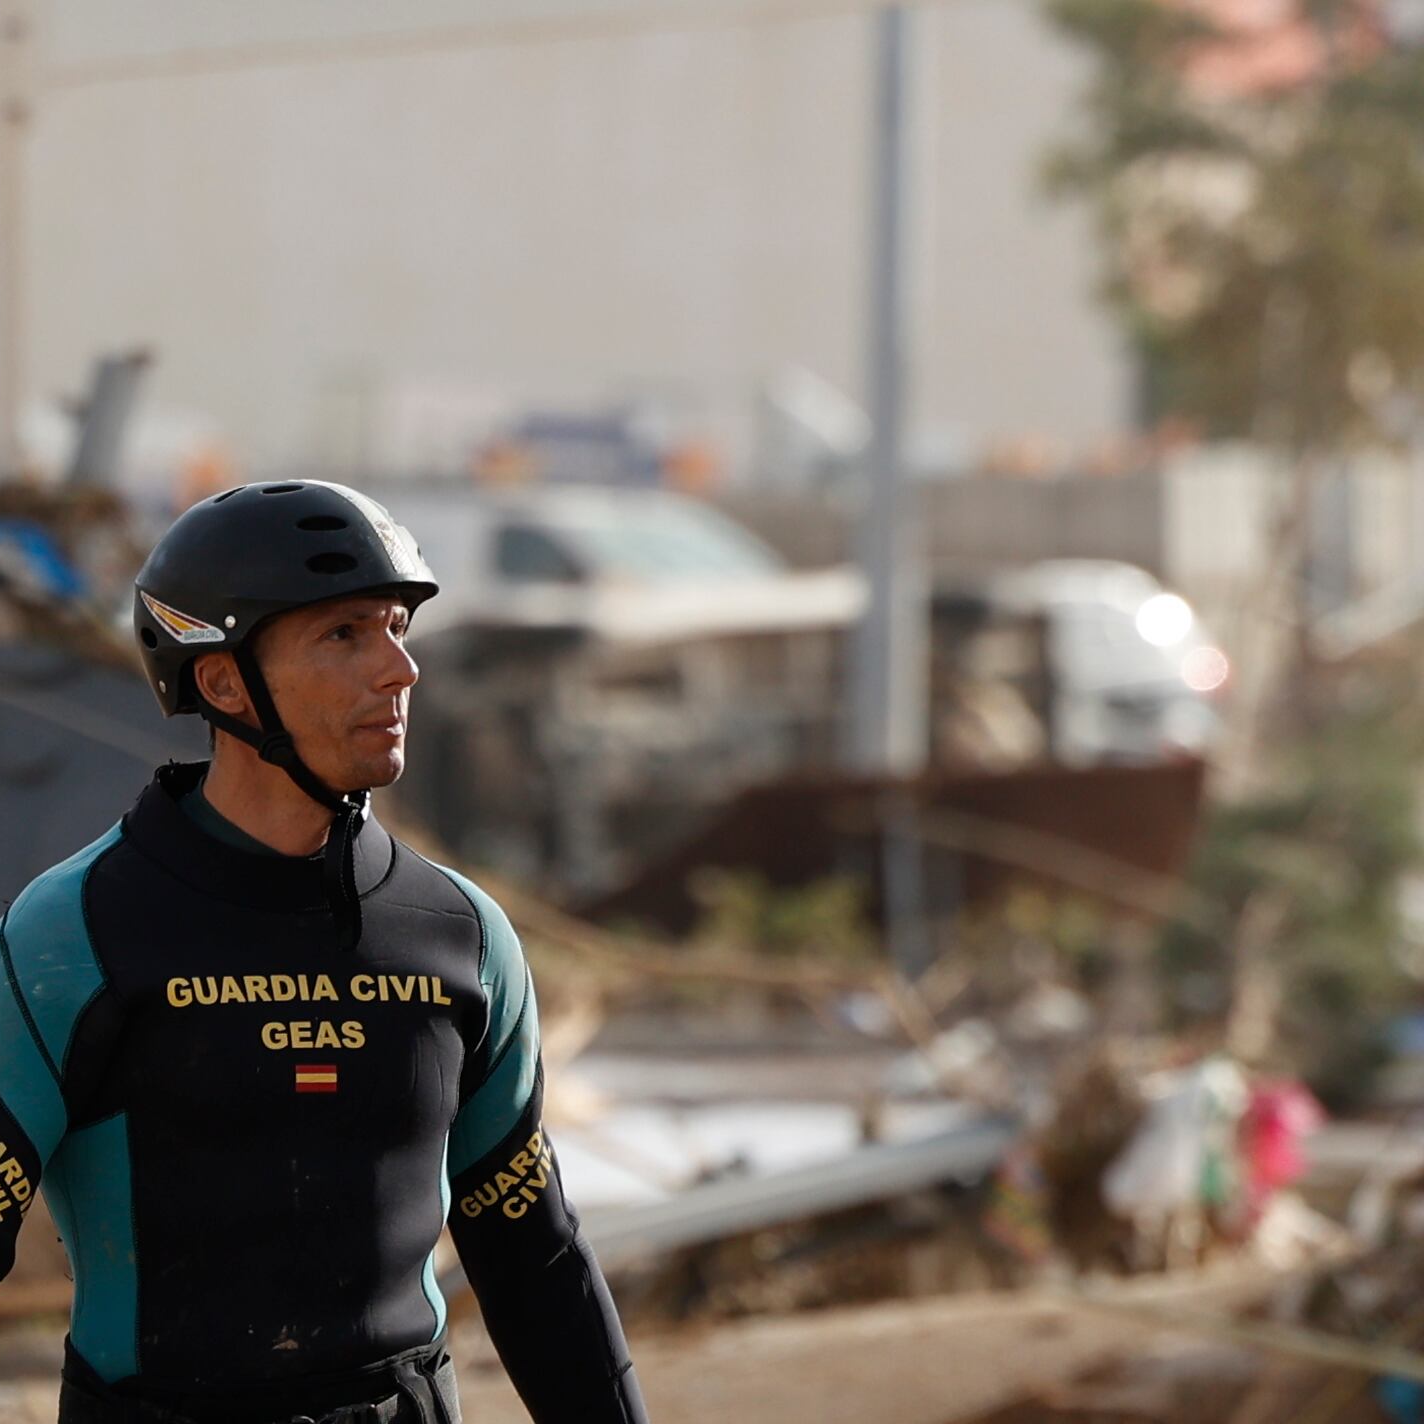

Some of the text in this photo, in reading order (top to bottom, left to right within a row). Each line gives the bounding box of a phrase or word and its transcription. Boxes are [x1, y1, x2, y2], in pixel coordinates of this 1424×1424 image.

[166, 974, 452, 1008] GUARDIA CIVIL
[261, 1021, 366, 1050] GEAS
